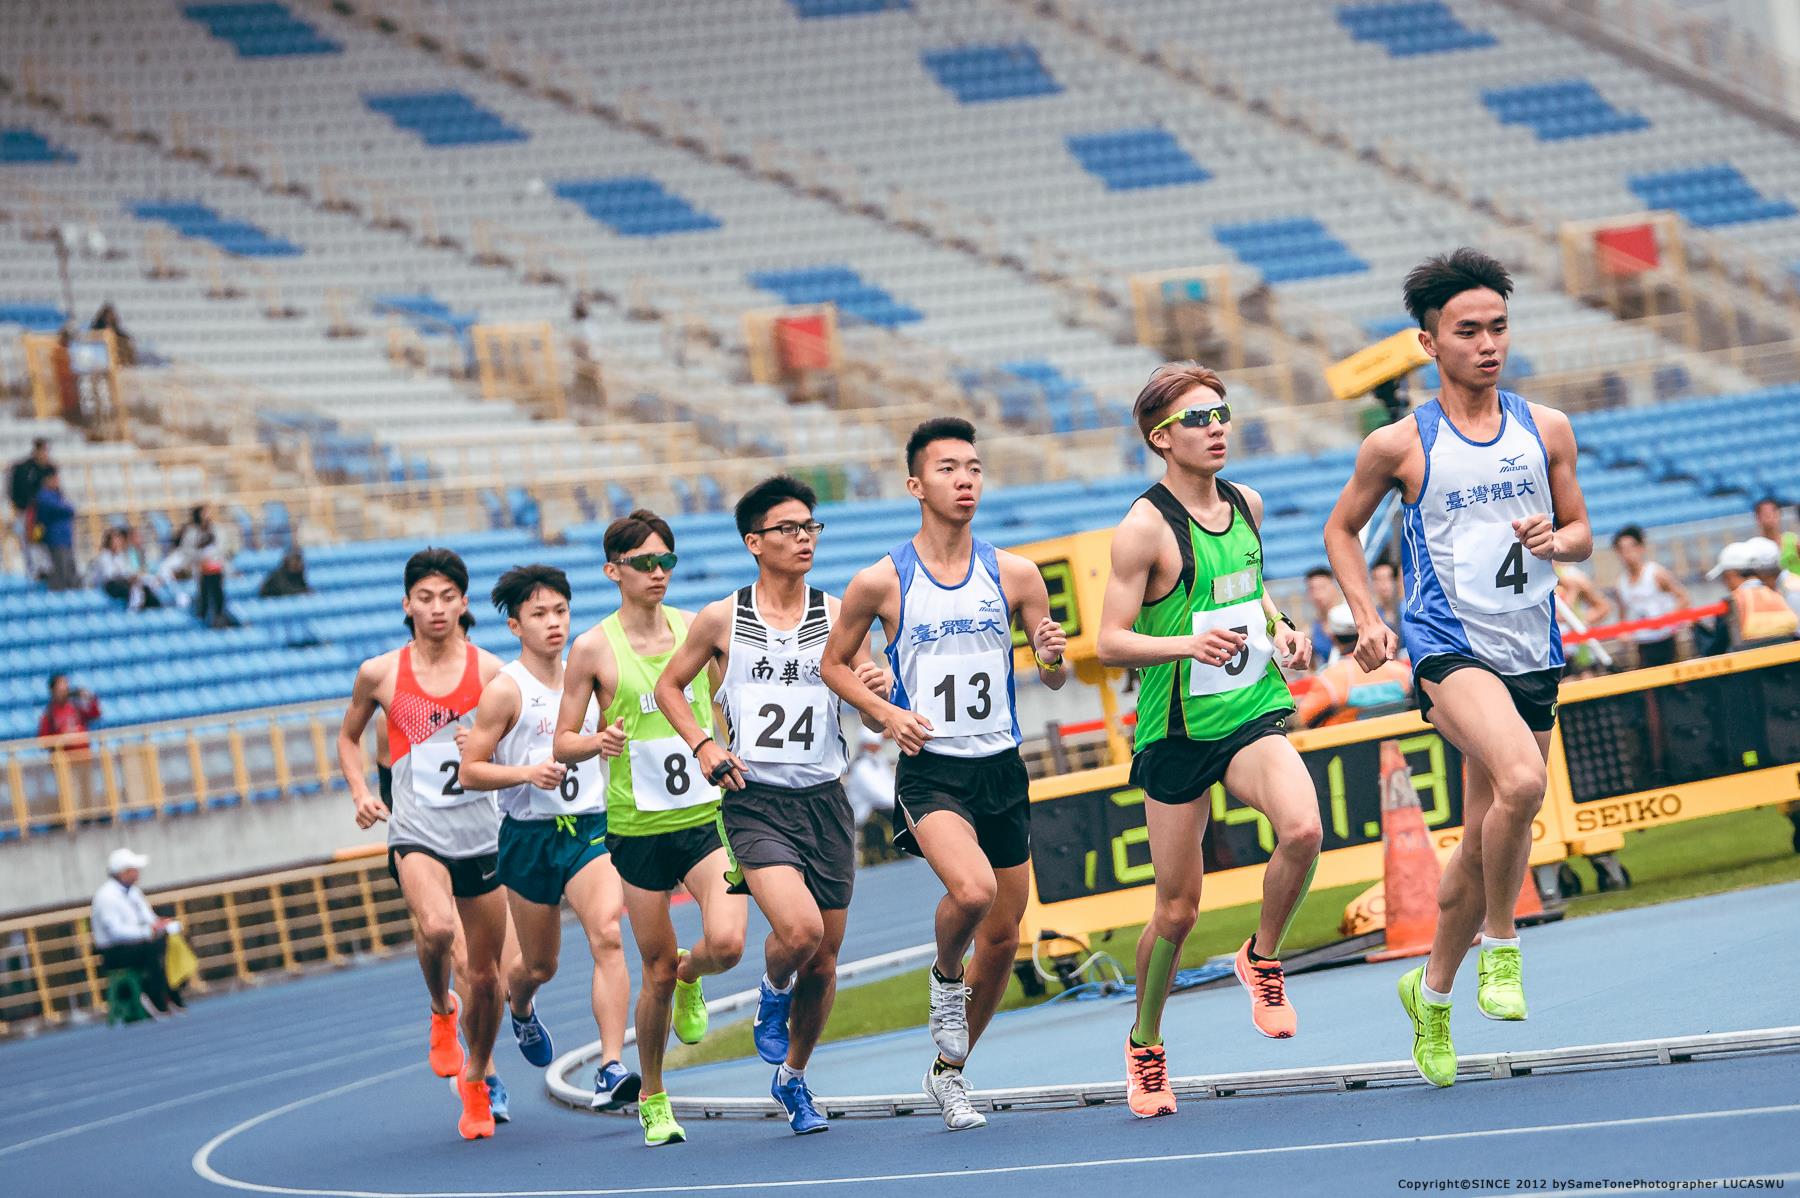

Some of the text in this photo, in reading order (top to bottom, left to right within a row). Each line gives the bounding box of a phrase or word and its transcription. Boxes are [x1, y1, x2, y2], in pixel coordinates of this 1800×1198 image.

[1445, 479, 1535, 512] 臺灣體大
[1495, 541, 1528, 595] 4
[911, 619, 1004, 646] 臺體大
[1225, 625, 1250, 677] 5
[934, 672, 992, 723] 13
[755, 703, 815, 751] 24
[440, 760, 464, 796] 2
[560, 762, 579, 802] 6
[664, 753, 691, 796] 8
[1575, 793, 1682, 832] SEIKO
